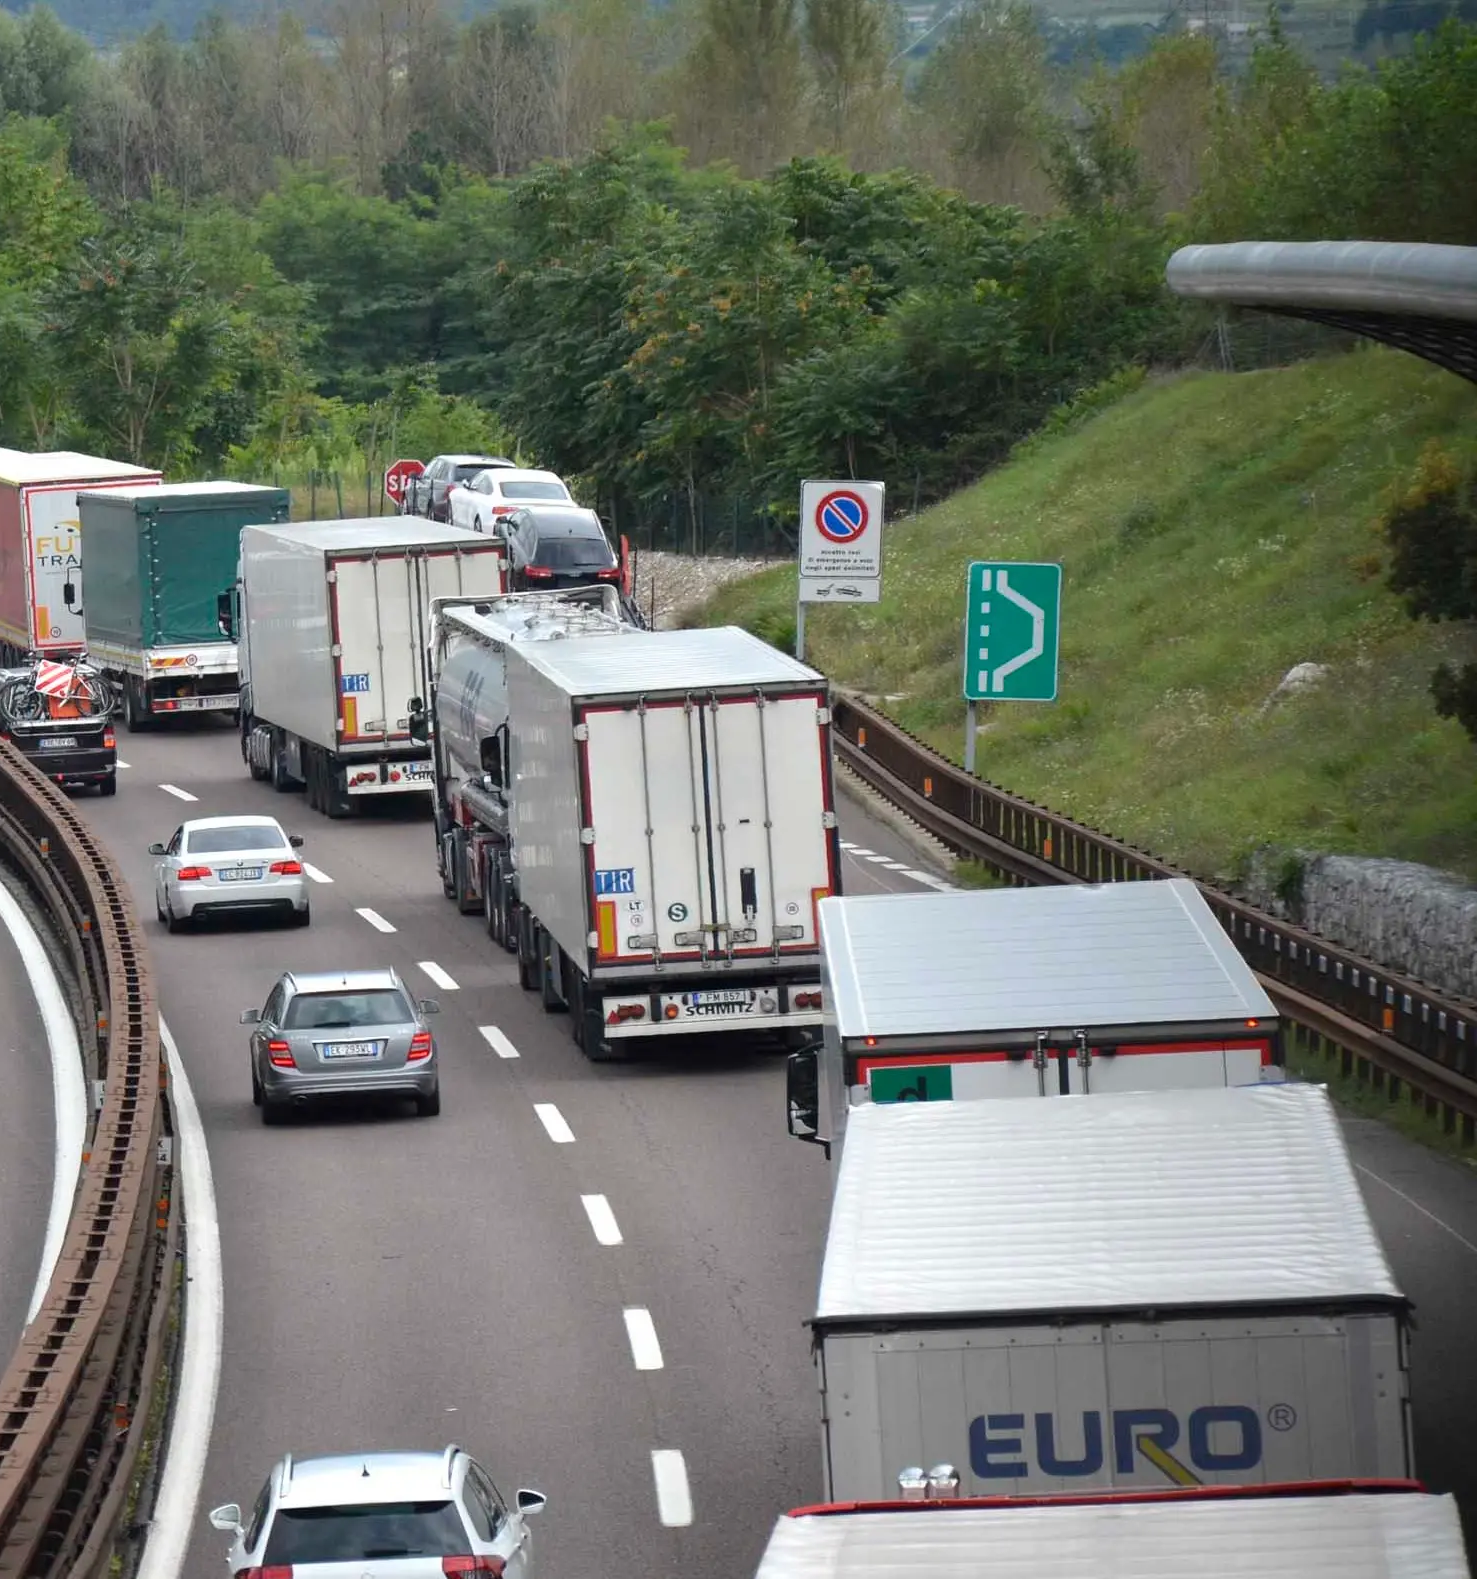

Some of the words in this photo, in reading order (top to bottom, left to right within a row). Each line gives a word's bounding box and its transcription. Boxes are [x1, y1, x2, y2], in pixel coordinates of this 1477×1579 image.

[36, 553, 83, 567] TRA
[342, 675, 368, 691] TIR
[597, 870, 632, 893] TIR
[629, 902, 641, 911] LT
[685, 1002, 755, 1017] SCHMITZ
[969, 1404, 1263, 1487] EURO
